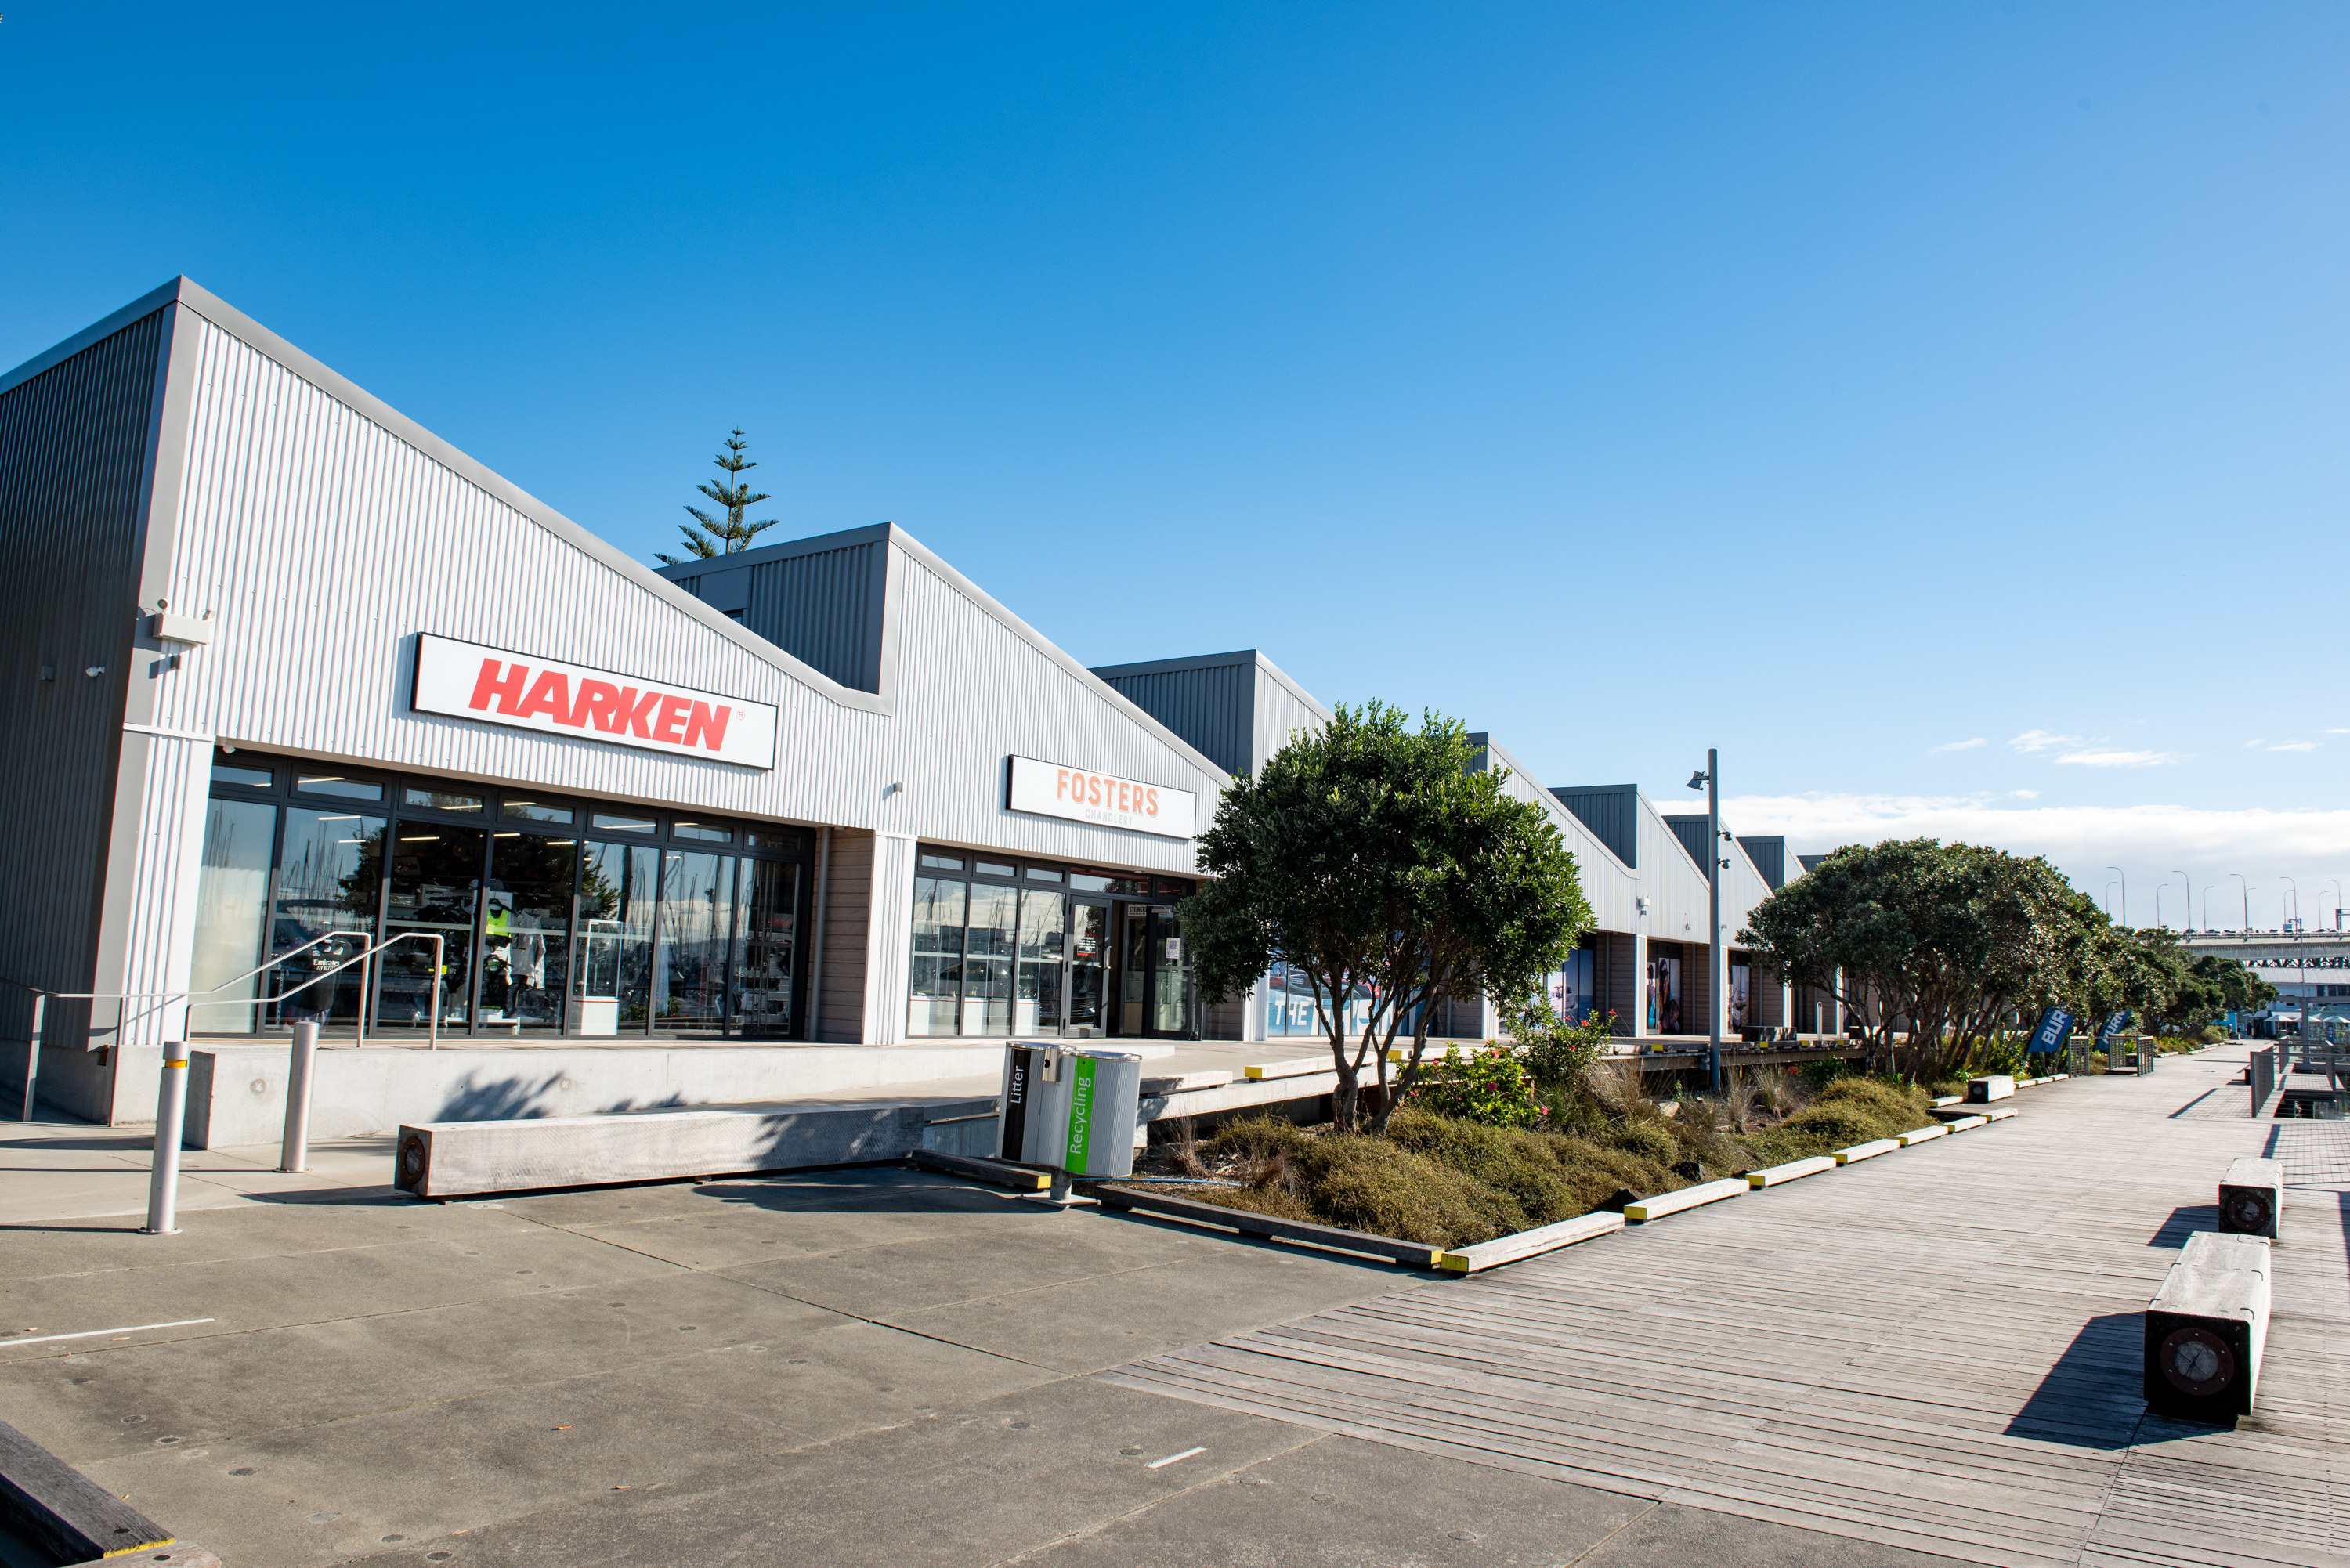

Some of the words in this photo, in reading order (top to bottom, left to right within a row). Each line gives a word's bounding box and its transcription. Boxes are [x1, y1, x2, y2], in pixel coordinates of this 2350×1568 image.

[468, 658, 732, 752] HARKEN
[1057, 768, 1159, 818] FOSTERS
[1085, 808, 1133, 826] CHANDLERY
[1274, 999, 1309, 1026] THE
[2041, 1007, 2068, 1045] BUR
[1010, 1064, 1024, 1104] Litter
[1069, 1076, 1092, 1154] Recycling
